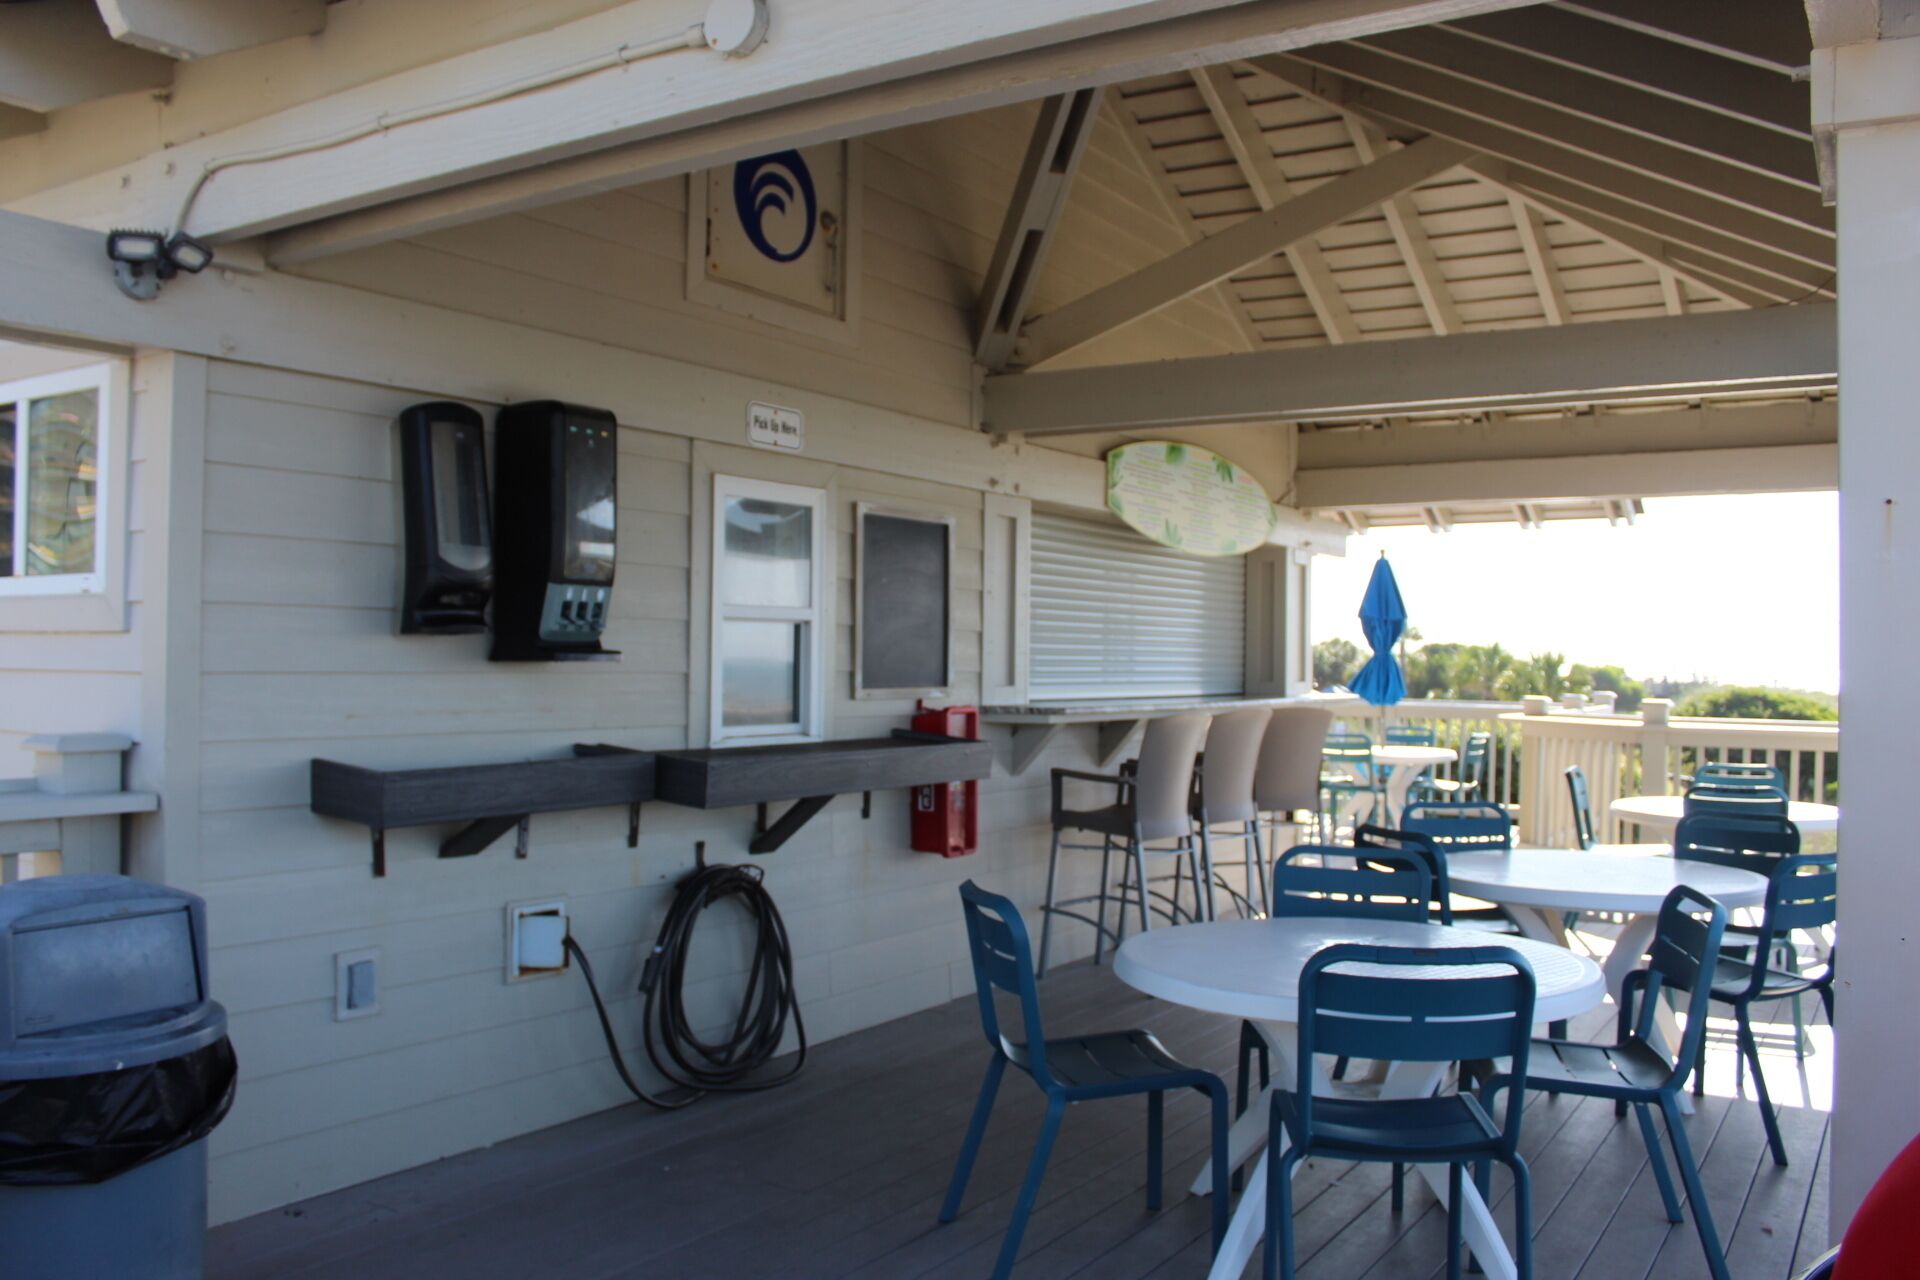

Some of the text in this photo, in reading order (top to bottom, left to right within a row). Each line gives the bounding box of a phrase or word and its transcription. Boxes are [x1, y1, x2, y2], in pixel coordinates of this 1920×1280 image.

[753, 414, 798, 435] Pick Up Here
